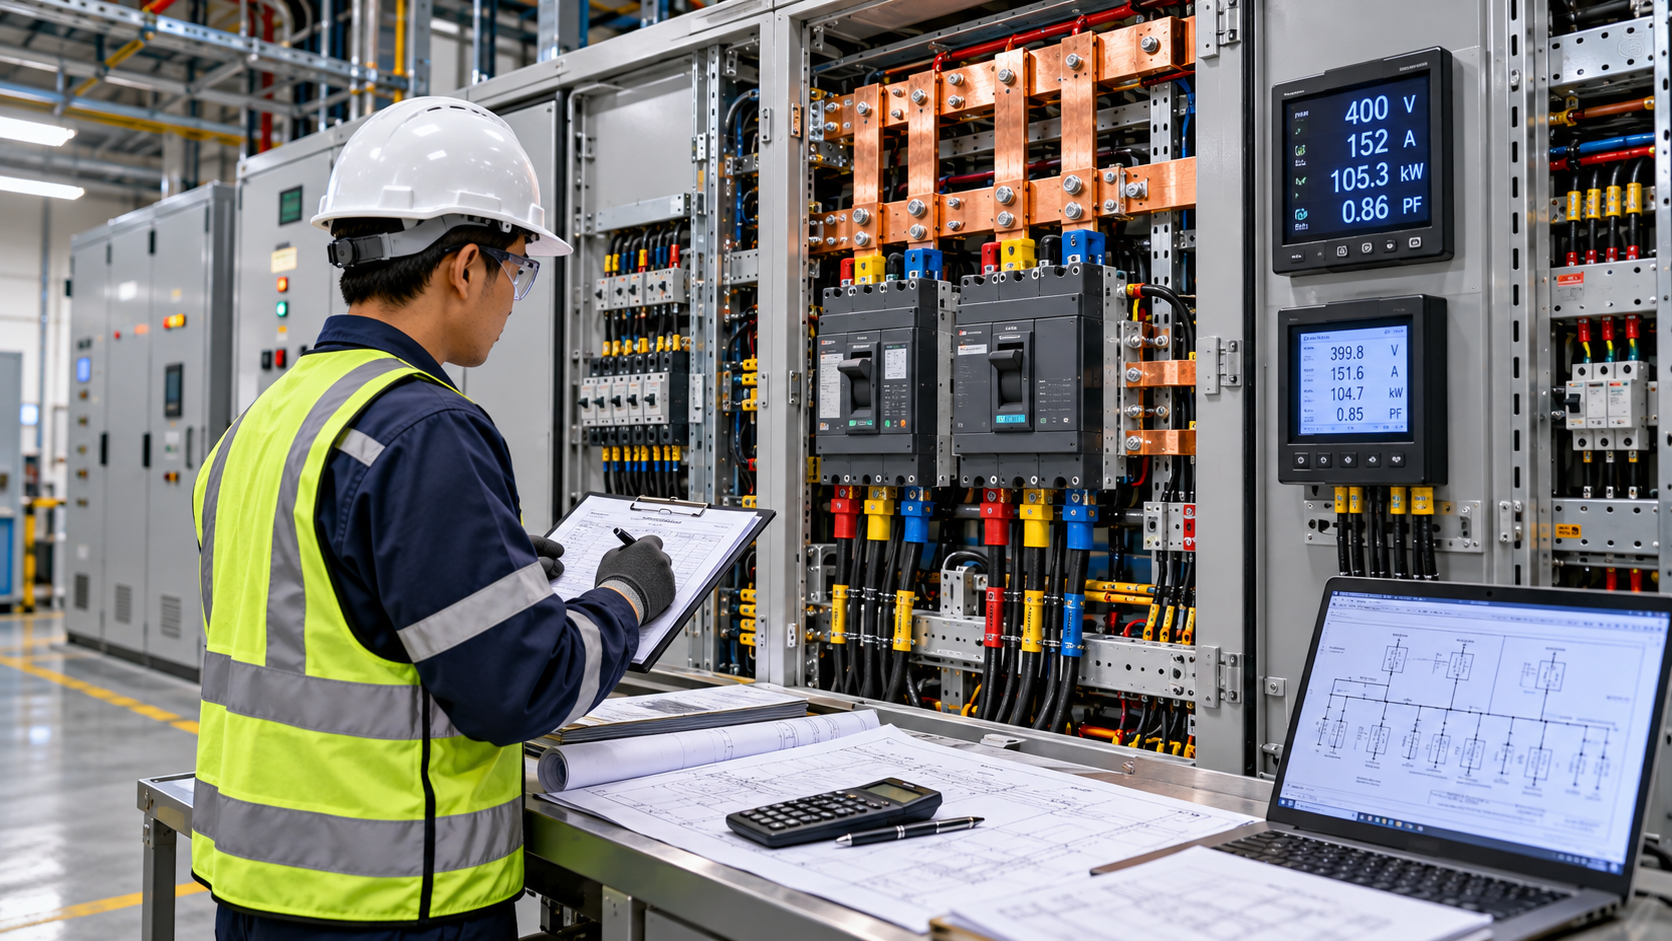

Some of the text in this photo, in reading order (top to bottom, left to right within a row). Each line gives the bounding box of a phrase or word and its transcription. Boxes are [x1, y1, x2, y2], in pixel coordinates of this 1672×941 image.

[1344, 94, 1416, 125] 400 V
[1347, 128, 1417, 158] 152 A
[1330, 161, 1424, 193] 105.3 kW
[1342, 194, 1422, 223] 0.86 PF
[1330, 345, 1364, 361] 399.8
[1390, 344, 1399, 356] V
[1330, 365, 1364, 381] 151.6
[1390, 365, 1399, 378] A
[1330, 386, 1364, 401] 104.7
[1389, 387, 1404, 399] kW
[1336, 407, 1403, 422] 0.85 PF
